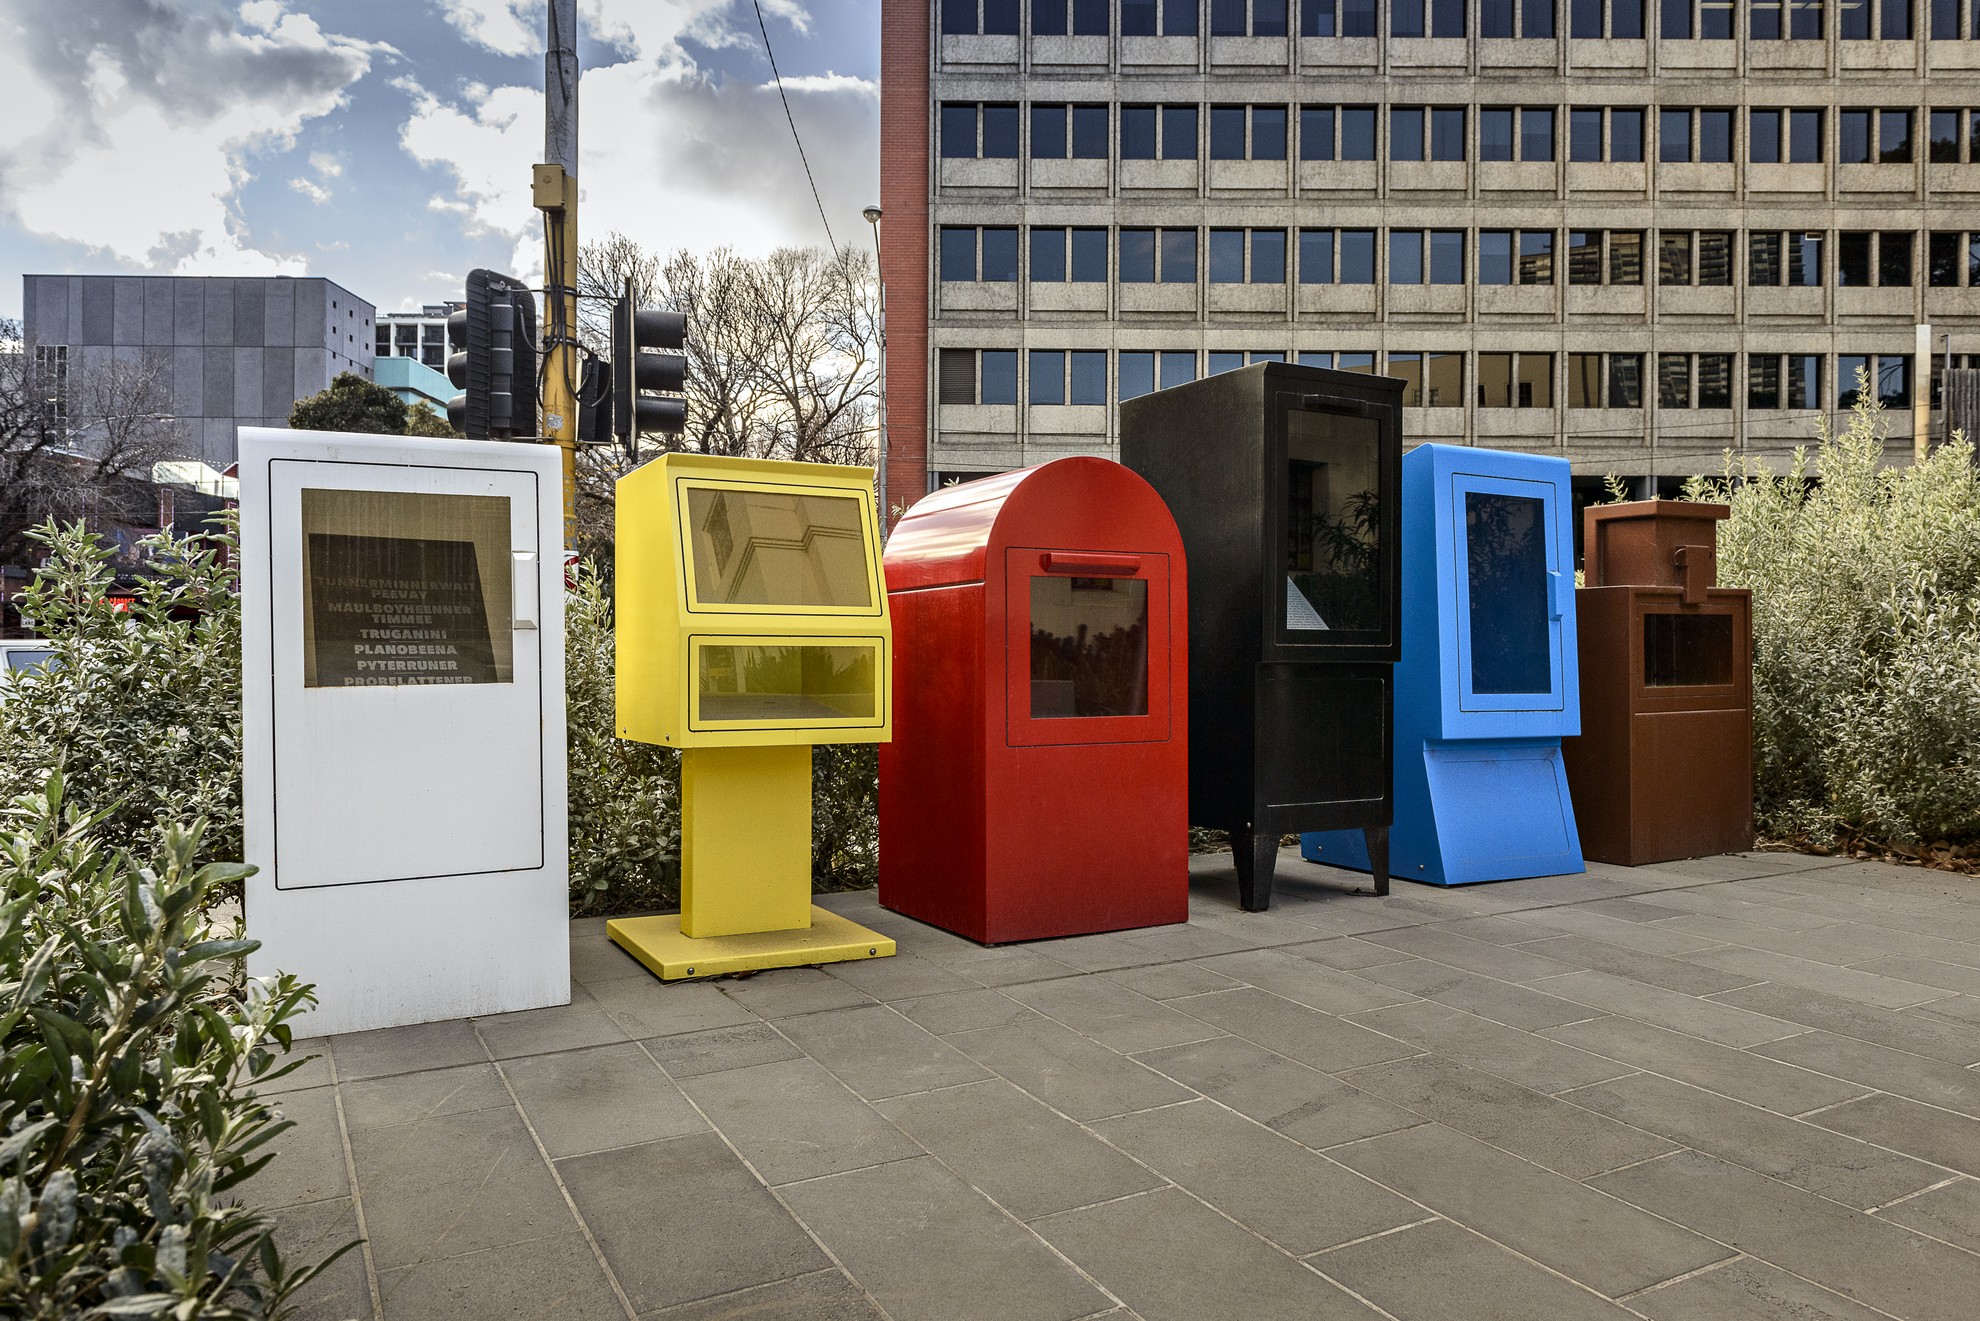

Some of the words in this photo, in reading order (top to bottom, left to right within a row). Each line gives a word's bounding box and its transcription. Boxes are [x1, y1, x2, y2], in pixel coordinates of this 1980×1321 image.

[371, 589, 428, 600] PEEVAY
[328, 602, 472, 615] MAULBOYHEENNER
[371, 614, 433, 624] TIMMEE
[360, 629, 447, 640] TRUGANINI
[354, 644, 458, 655] PLANOBEENA
[357, 660, 458, 671] PYTERRUNER
